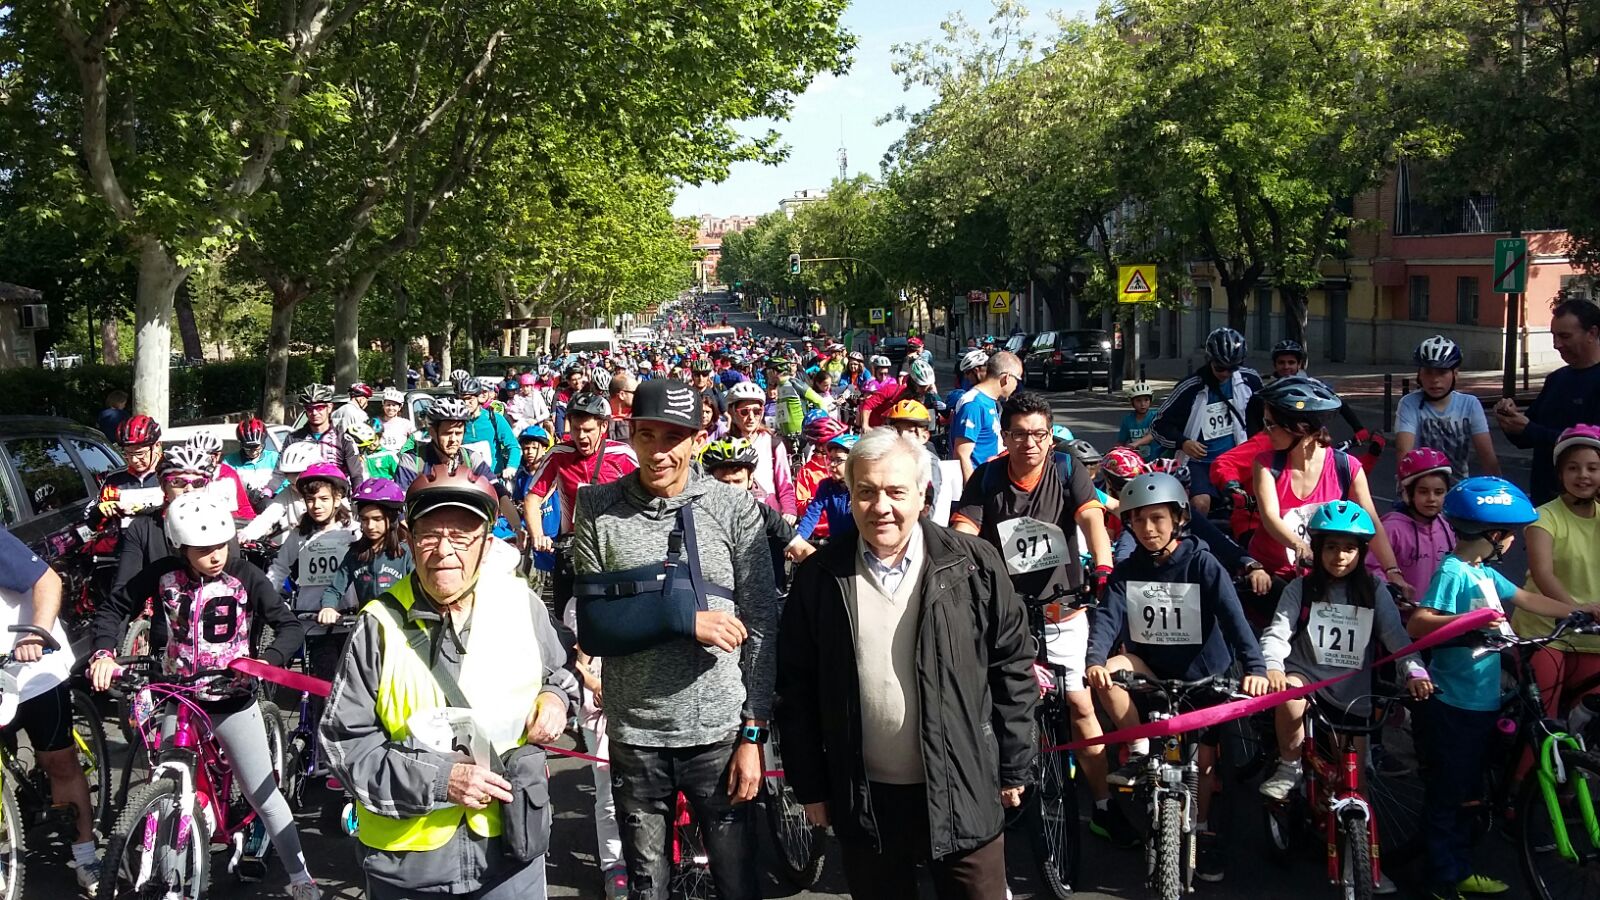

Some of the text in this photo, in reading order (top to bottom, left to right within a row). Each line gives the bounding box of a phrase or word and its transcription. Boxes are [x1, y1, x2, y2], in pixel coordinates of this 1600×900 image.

[1016, 533, 1052, 559] 971
[309, 555, 339, 575] 690
[1143, 605, 1182, 630] 911
[1317, 625, 1355, 652] 121
